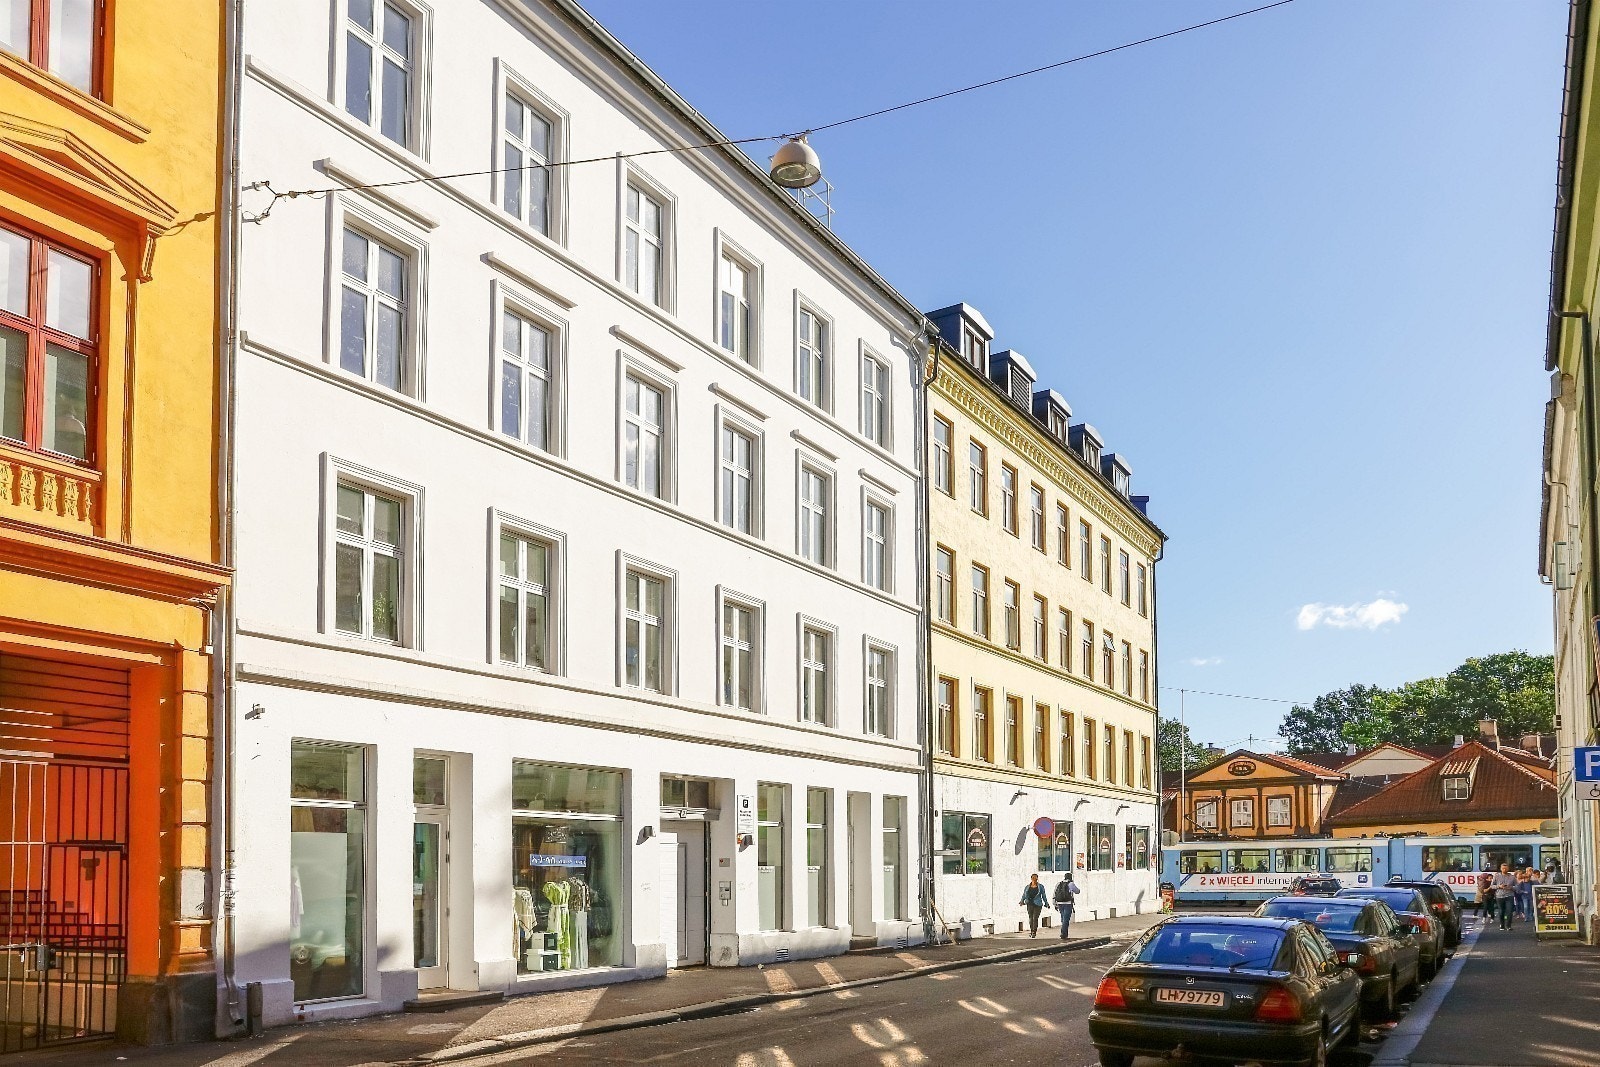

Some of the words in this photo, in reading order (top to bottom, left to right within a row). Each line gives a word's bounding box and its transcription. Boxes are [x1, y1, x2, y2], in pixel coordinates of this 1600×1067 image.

[1200, 876, 1206, 885] 2
[1216, 875, 1255, 887] WIĘCEJ
[1448, 875, 1480, 885] DOB
[1159, 989, 1221, 1004] LH79779
